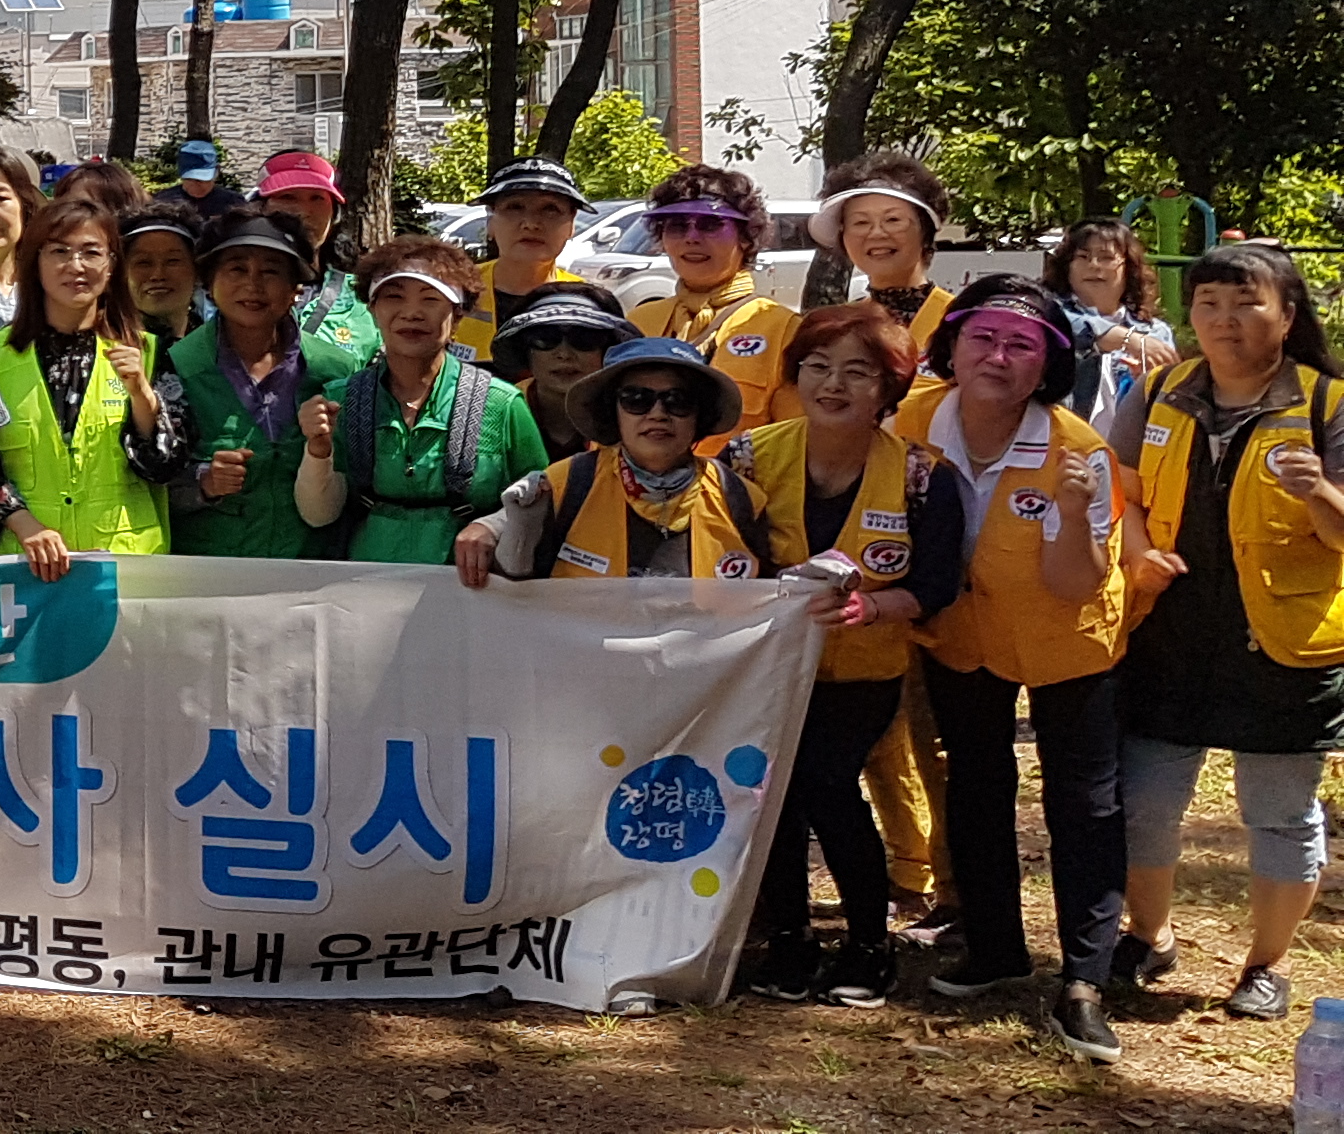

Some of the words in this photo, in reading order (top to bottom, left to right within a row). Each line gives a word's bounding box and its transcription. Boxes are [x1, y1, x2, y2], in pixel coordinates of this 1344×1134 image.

[174, 727, 496, 905] 실시
[620, 819, 686, 851] 장평
[154, 926, 286, 985] 관내
[312, 916, 573, 983] 유관단체
